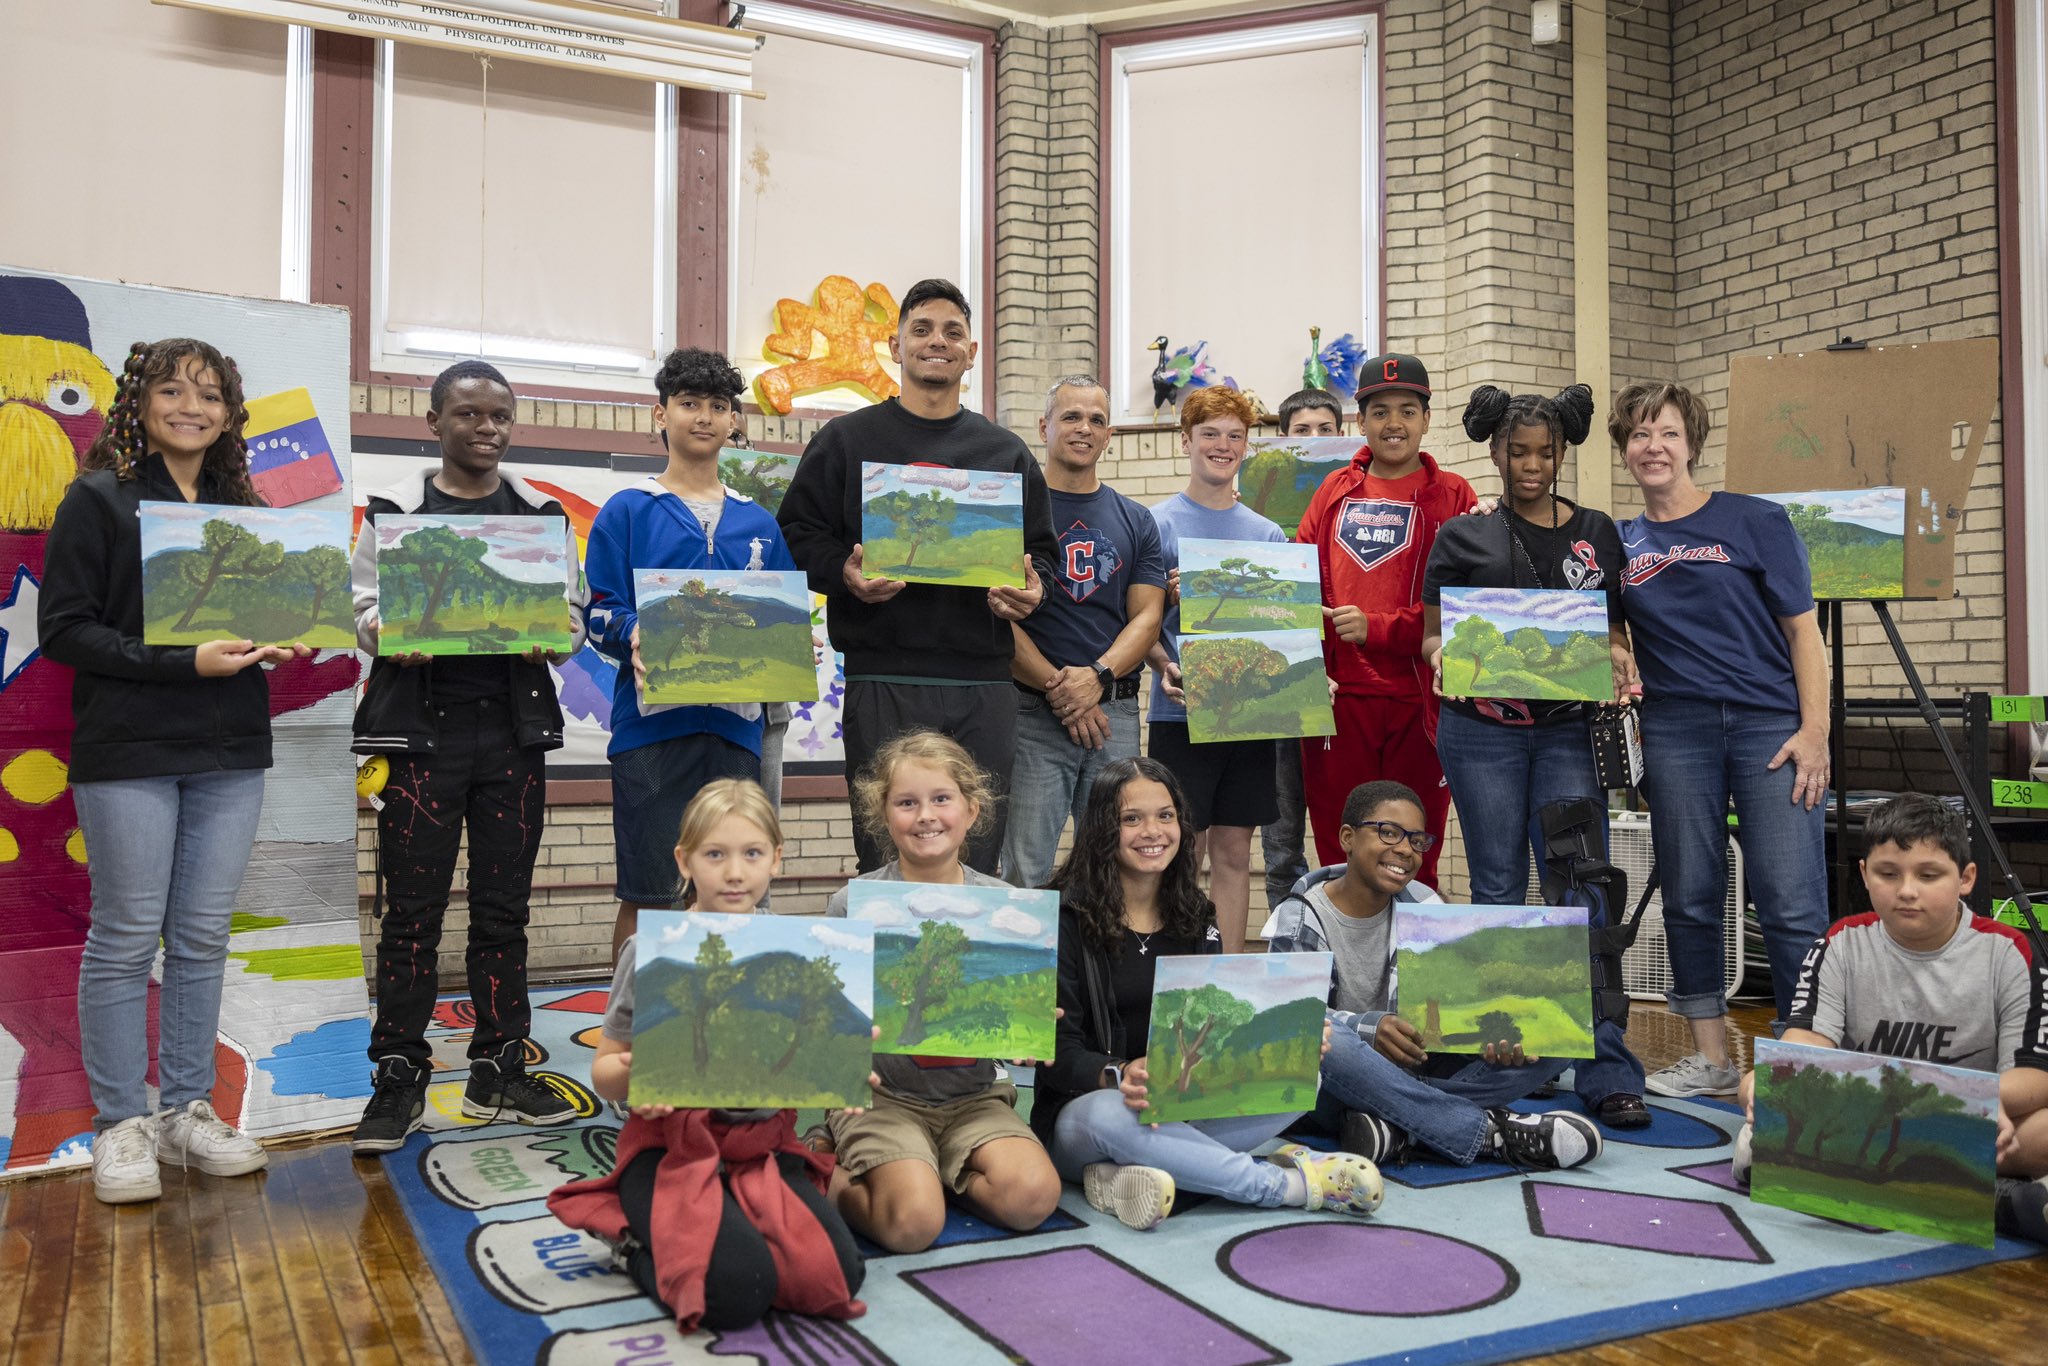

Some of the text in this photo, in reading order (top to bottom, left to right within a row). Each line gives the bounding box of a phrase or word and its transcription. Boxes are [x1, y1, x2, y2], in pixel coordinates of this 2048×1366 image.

[358, 14, 386, 25] RAND
[445, 28, 560, 54] PHYSICAL/POLITICAL
[565, 48, 607, 61] ALASKA
[421, 5, 538, 31] PHYSICAL/POLITICAL
[542, 25, 582, 38] UNITED
[585, 32, 625, 46] STATES
[1384, 359, 1398, 381] C
[1066, 541, 1094, 583] C
[2001, 700, 2017, 714] 131
[2001, 785, 2032, 804] 238
[1868, 1020, 1957, 1064] NIKE
[470, 1147, 543, 1192] GREEN
[532, 1233, 609, 1281] BLUE
